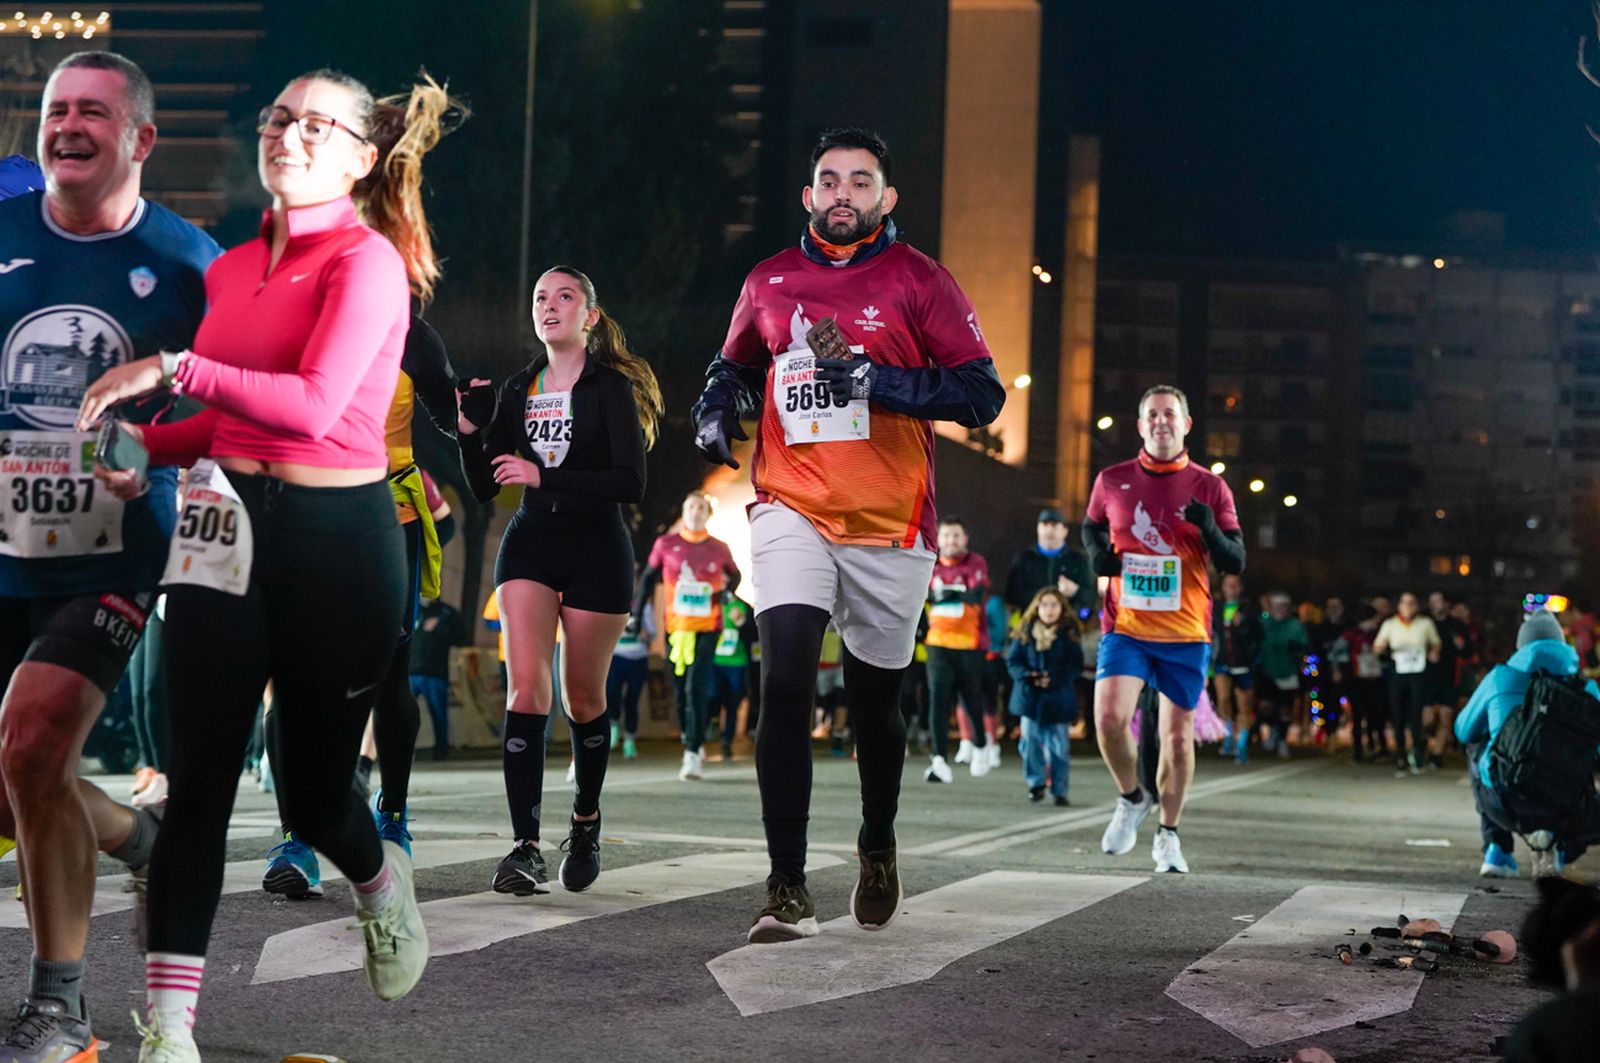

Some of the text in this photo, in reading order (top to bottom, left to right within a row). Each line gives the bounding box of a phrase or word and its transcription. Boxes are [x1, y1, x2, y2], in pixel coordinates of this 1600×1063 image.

[788, 359, 813, 371] NOCHE
[781, 372, 796, 385] SAN
[812, 411, 833, 419] Carlos
[527, 419, 574, 443] 2423
[2, 460, 22, 473] SAN
[12, 477, 95, 514] 3637
[1143, 531, 1159, 547] 43
[1131, 574, 1170, 593] 12110
